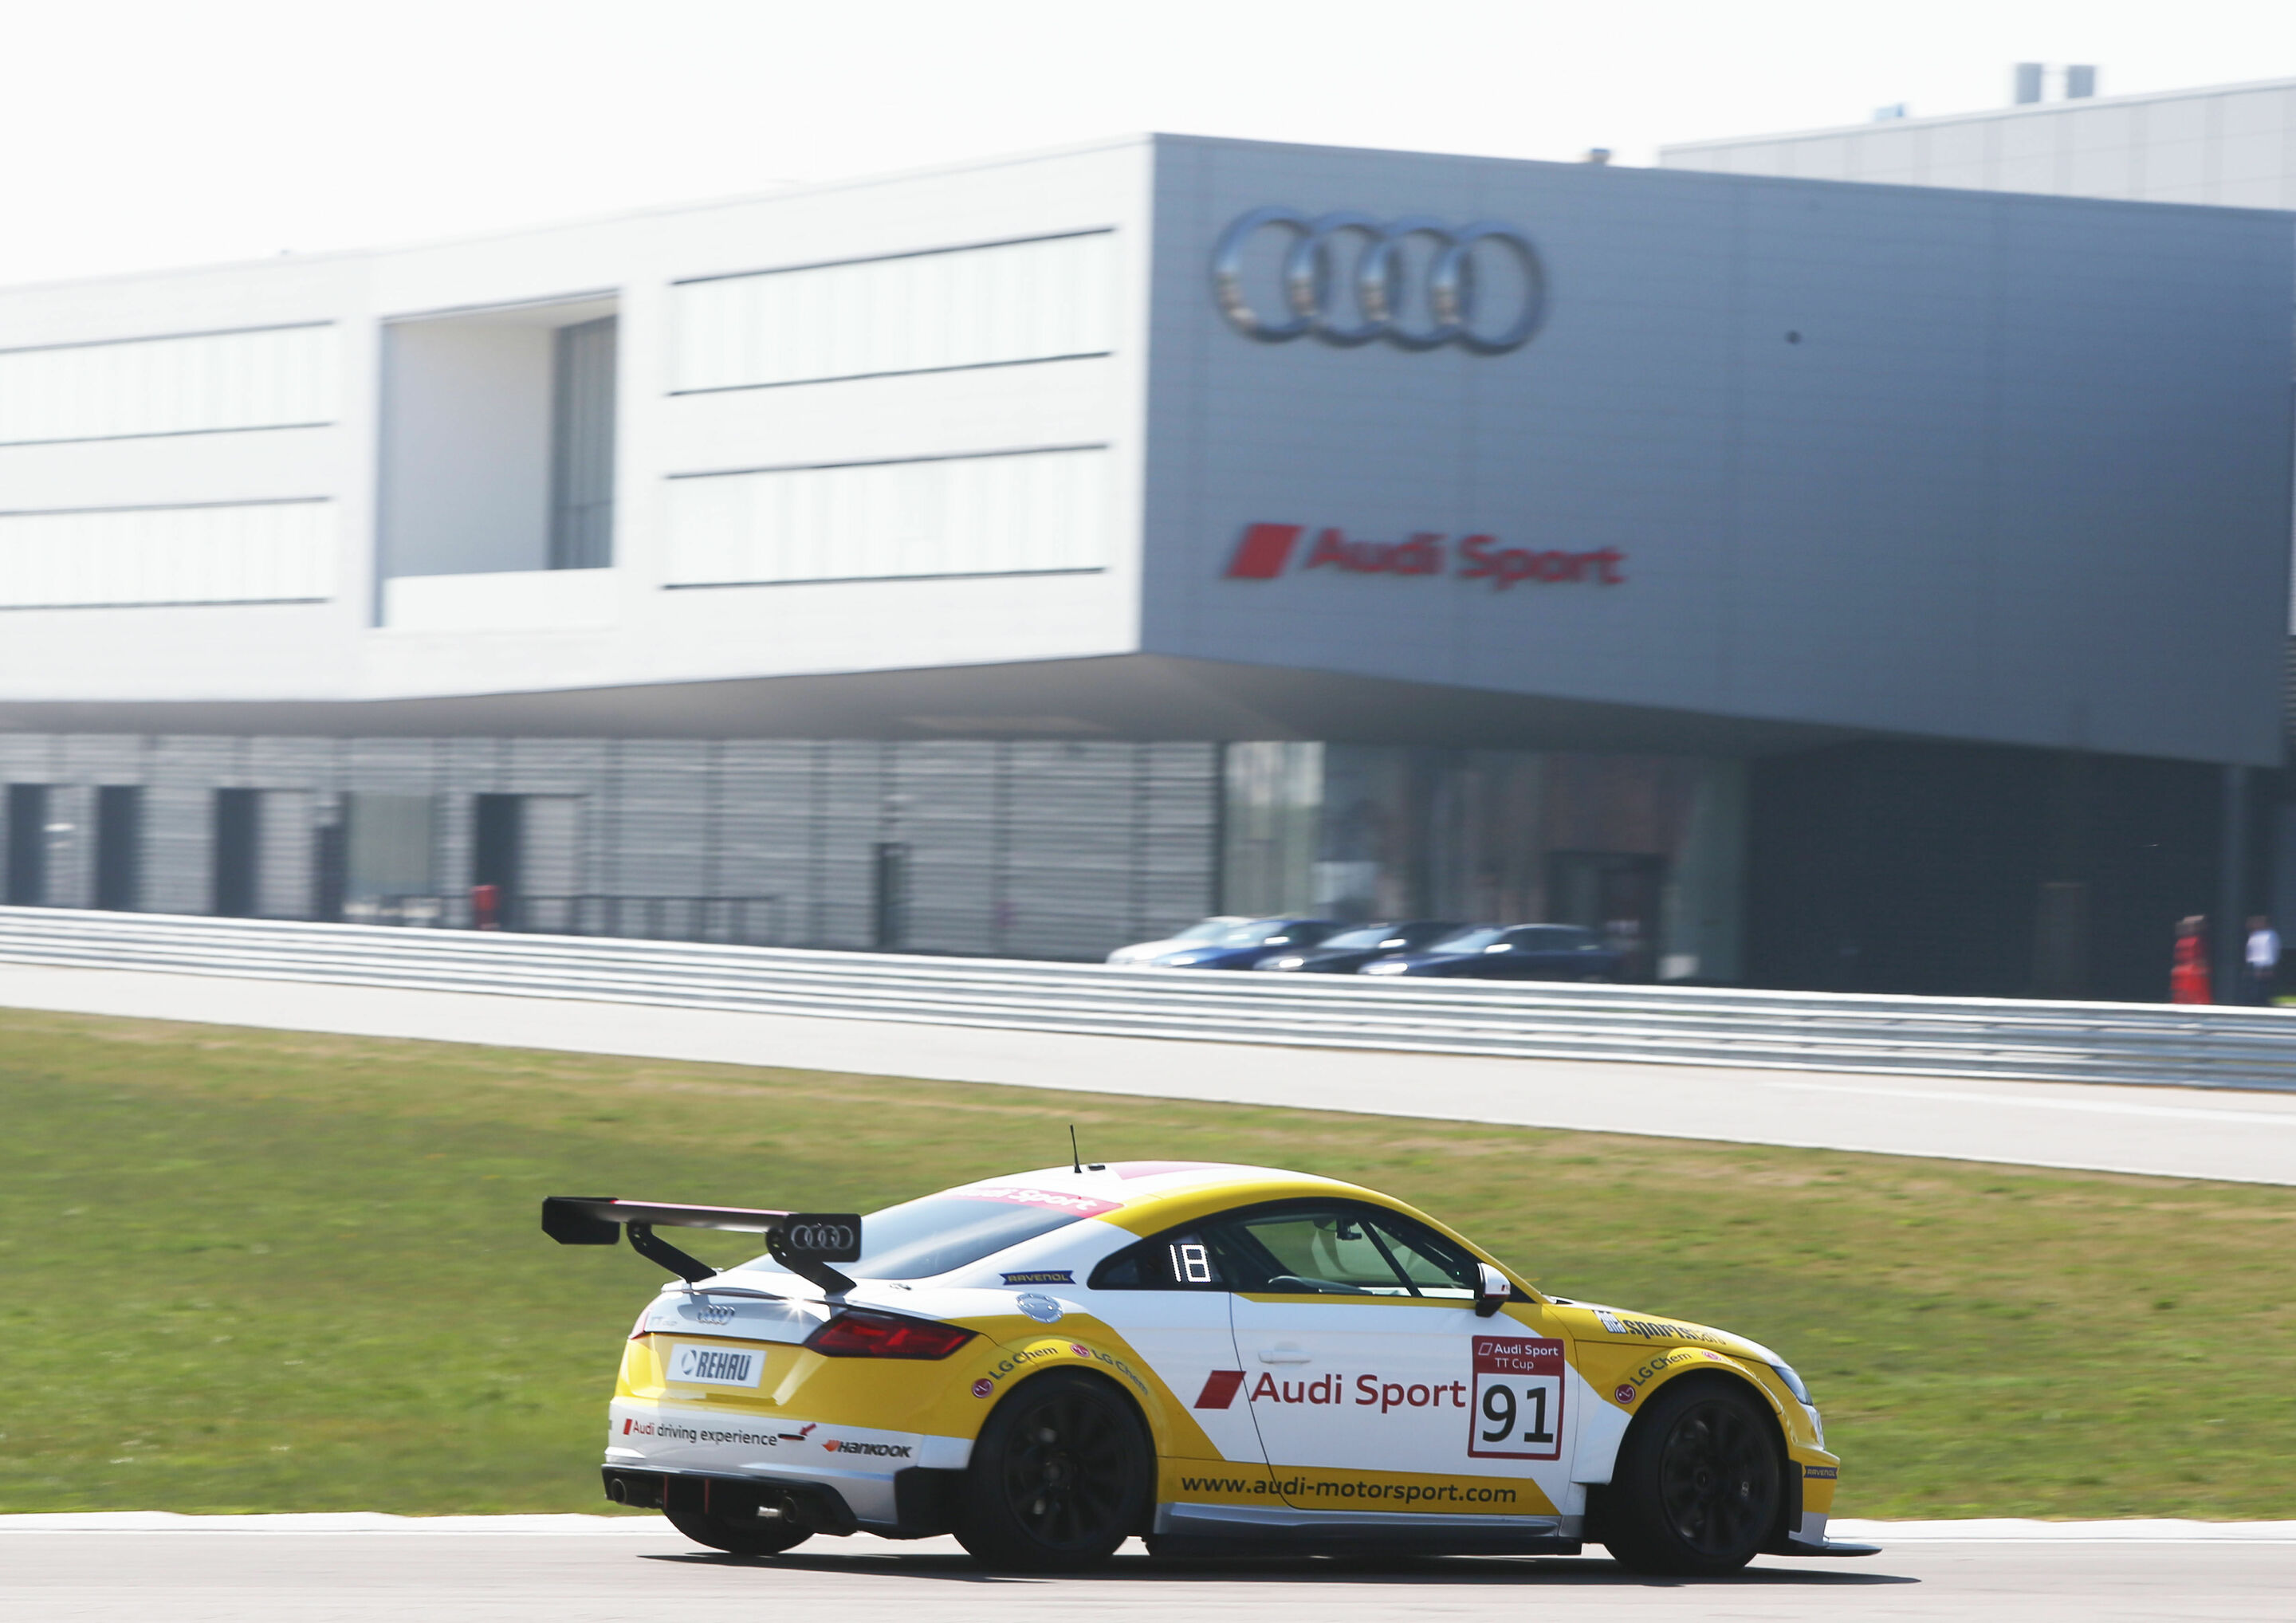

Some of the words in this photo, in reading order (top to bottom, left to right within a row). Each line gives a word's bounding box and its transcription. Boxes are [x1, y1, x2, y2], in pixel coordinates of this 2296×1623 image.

[1305, 528, 1446, 574] Audi
[1457, 534, 1626, 591] Sport
[1170, 1244, 1212, 1283] 18
[696, 1351, 753, 1381] REHAU
[988, 1359, 1015, 1380] LG
[1012, 1346, 1059, 1365] Chem
[1494, 1344, 1522, 1354] Audi
[1525, 1345, 1559, 1358] Sport
[1495, 1358, 1509, 1368] TT
[1512, 1359, 1535, 1370] Cup
[1091, 1349, 1115, 1366] LG
[1115, 1360, 1149, 1396] Chem
[1630, 1366, 1654, 1387] LG
[1650, 1351, 1693, 1370] Chem
[1251, 1372, 1343, 1405] Audi
[1355, 1374, 1466, 1414] Sport
[1482, 1384, 1554, 1444] 91
[633, 1421, 655, 1435] Audi
[657, 1423, 697, 1444] driving
[700, 1429, 778, 1446] experience
[1181, 1476, 1516, 1504] www.audi-motorsport.com
